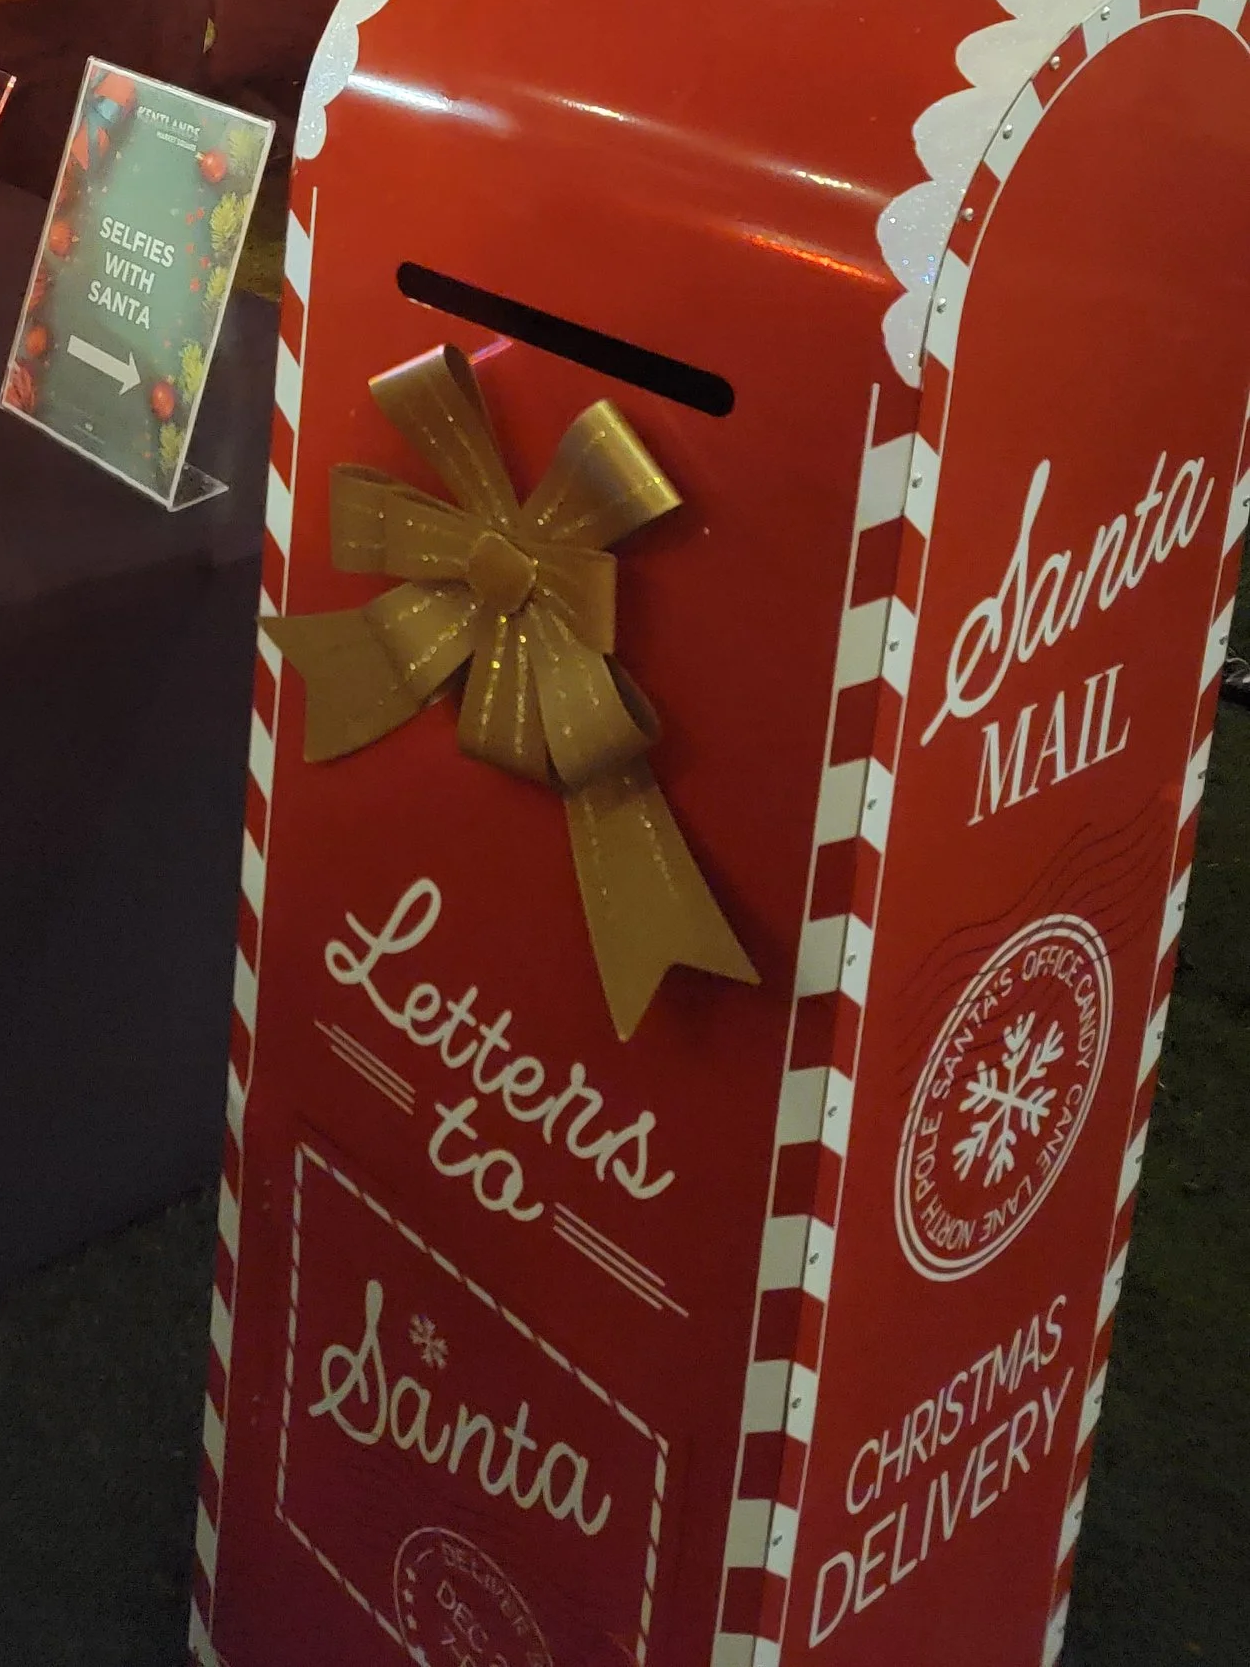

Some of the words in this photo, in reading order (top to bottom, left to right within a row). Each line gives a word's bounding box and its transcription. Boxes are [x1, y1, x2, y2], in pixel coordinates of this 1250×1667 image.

[100, 216, 175, 268] SELFIES
[105, 251, 156, 295] WITH
[88, 280, 151, 330] SANTA
[920, 450, 1215, 747] Santa
[967, 663, 1131, 827] MAIL
[1020, 944, 1086, 988] OFFICE
[324, 877, 676, 1200] Letters
[932, 966, 1014, 1100] SANTA'S
[1073, 973, 1100, 1070] CANDY
[428, 1097, 545, 1222] to
[913, 1115, 944, 1203] POLE
[1036, 1083, 1084, 1179] CANE
[919, 1192, 977, 1252] NORTH
[978, 1173, 1033, 1243] LANE
[308, 1279, 612, 1536] Santa
[845, 1294, 1067, 1516] CHRISTMAS
[808, 1367, 1075, 1649] DELIVERY
[436, 1579, 489, 1654] DEC
